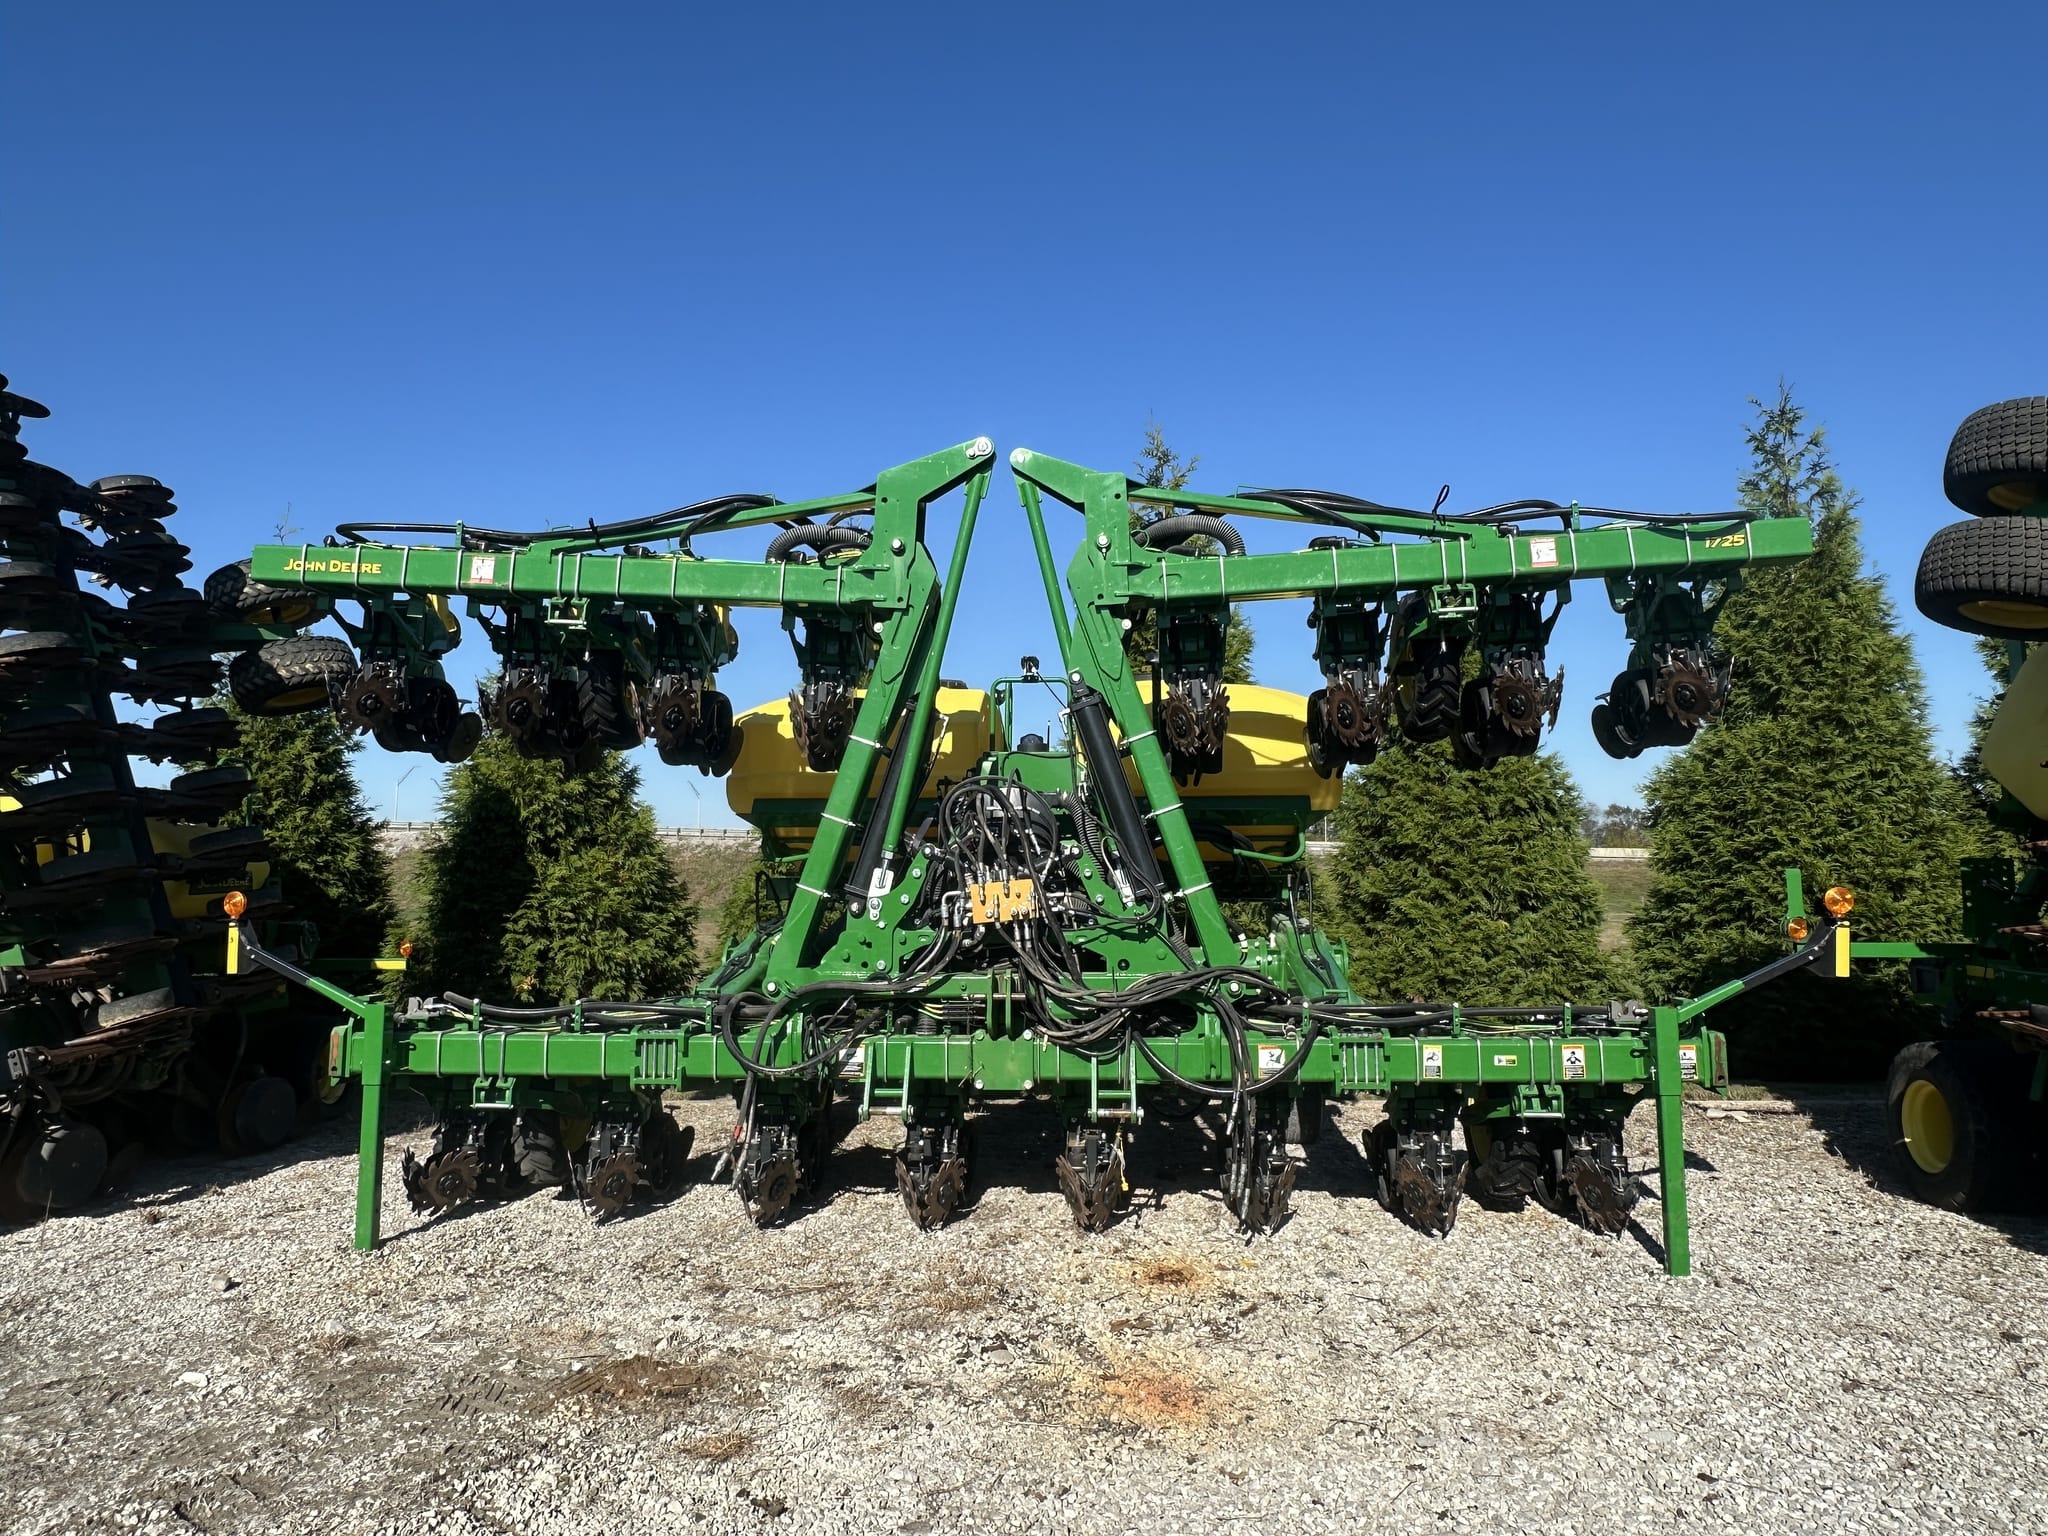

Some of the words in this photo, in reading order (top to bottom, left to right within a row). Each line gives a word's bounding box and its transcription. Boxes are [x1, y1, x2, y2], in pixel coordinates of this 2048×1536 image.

[1705, 534, 1745, 549] 1725
[283, 558, 327, 572] JOHN
[329, 559, 382, 574] DEERE
